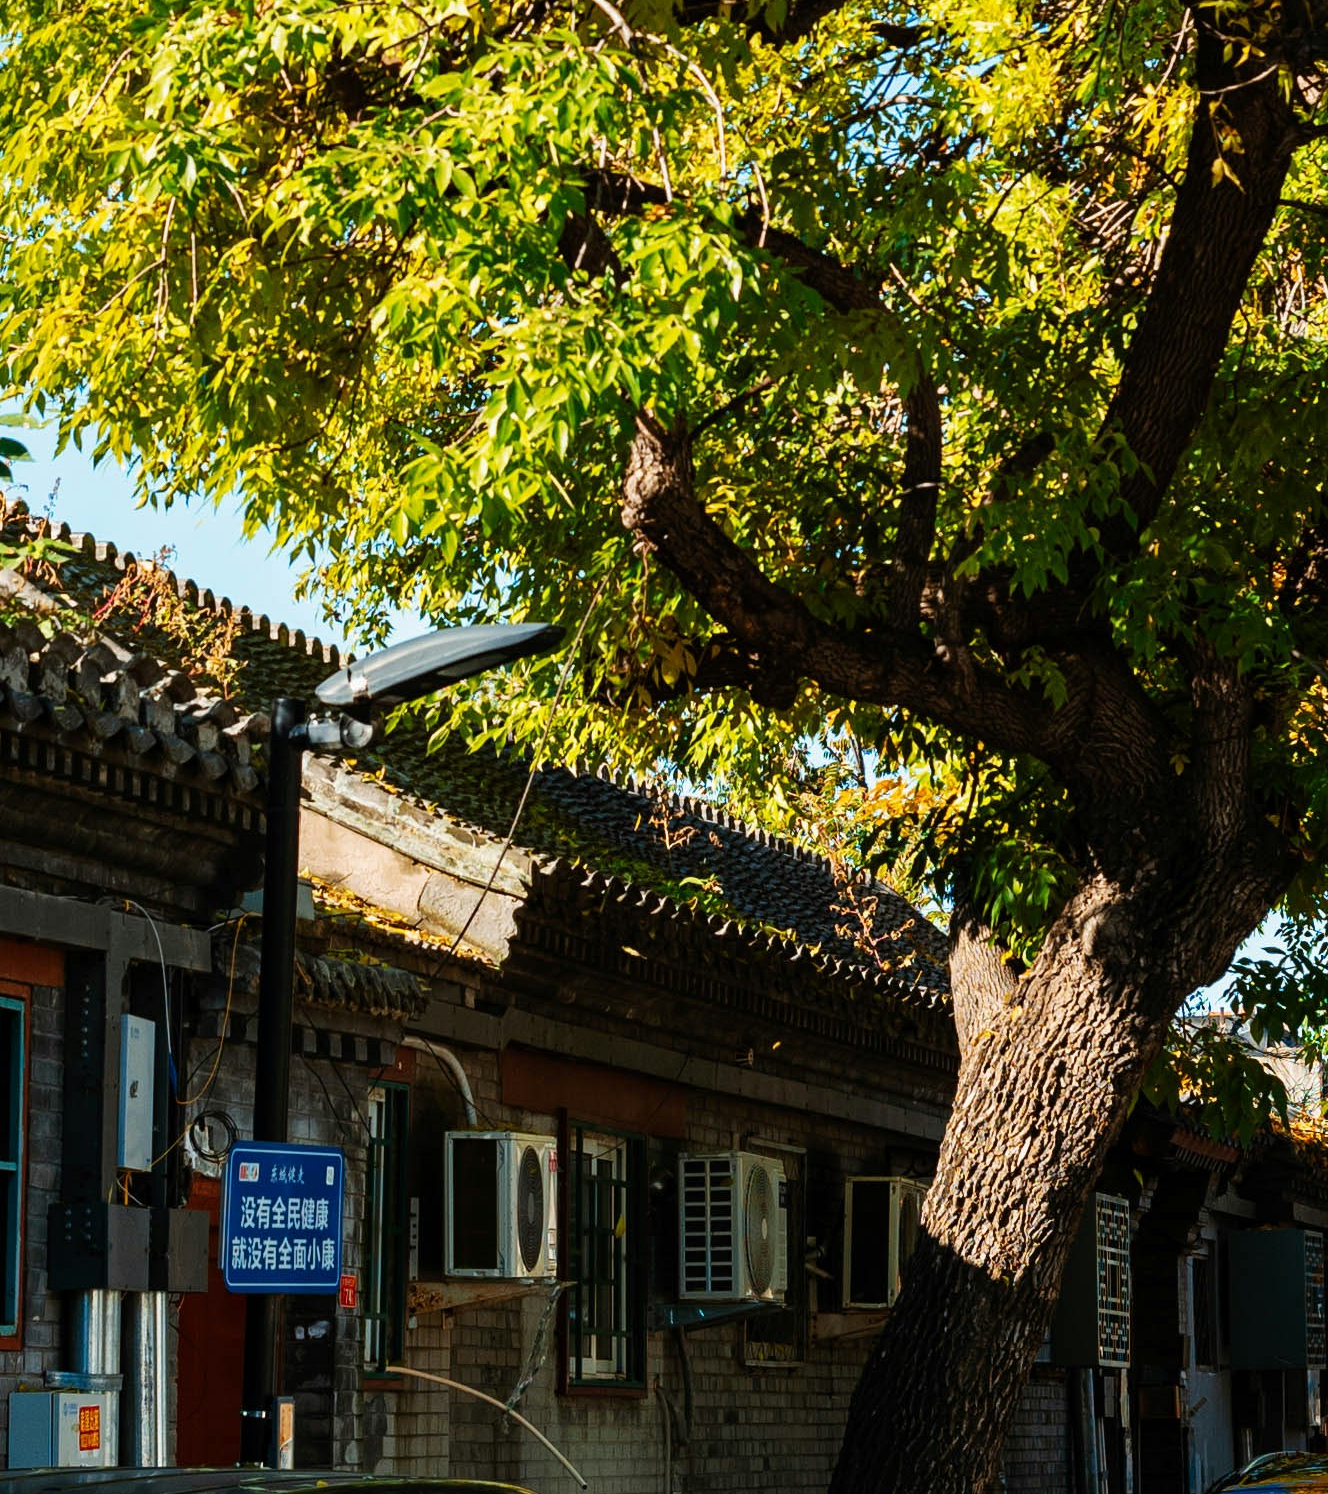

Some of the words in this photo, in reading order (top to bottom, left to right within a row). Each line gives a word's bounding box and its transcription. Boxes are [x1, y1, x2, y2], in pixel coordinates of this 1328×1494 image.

[240, 1196, 329, 1230] 没有全民健康
[231, 1236, 336, 1271] 就没有全面小康
